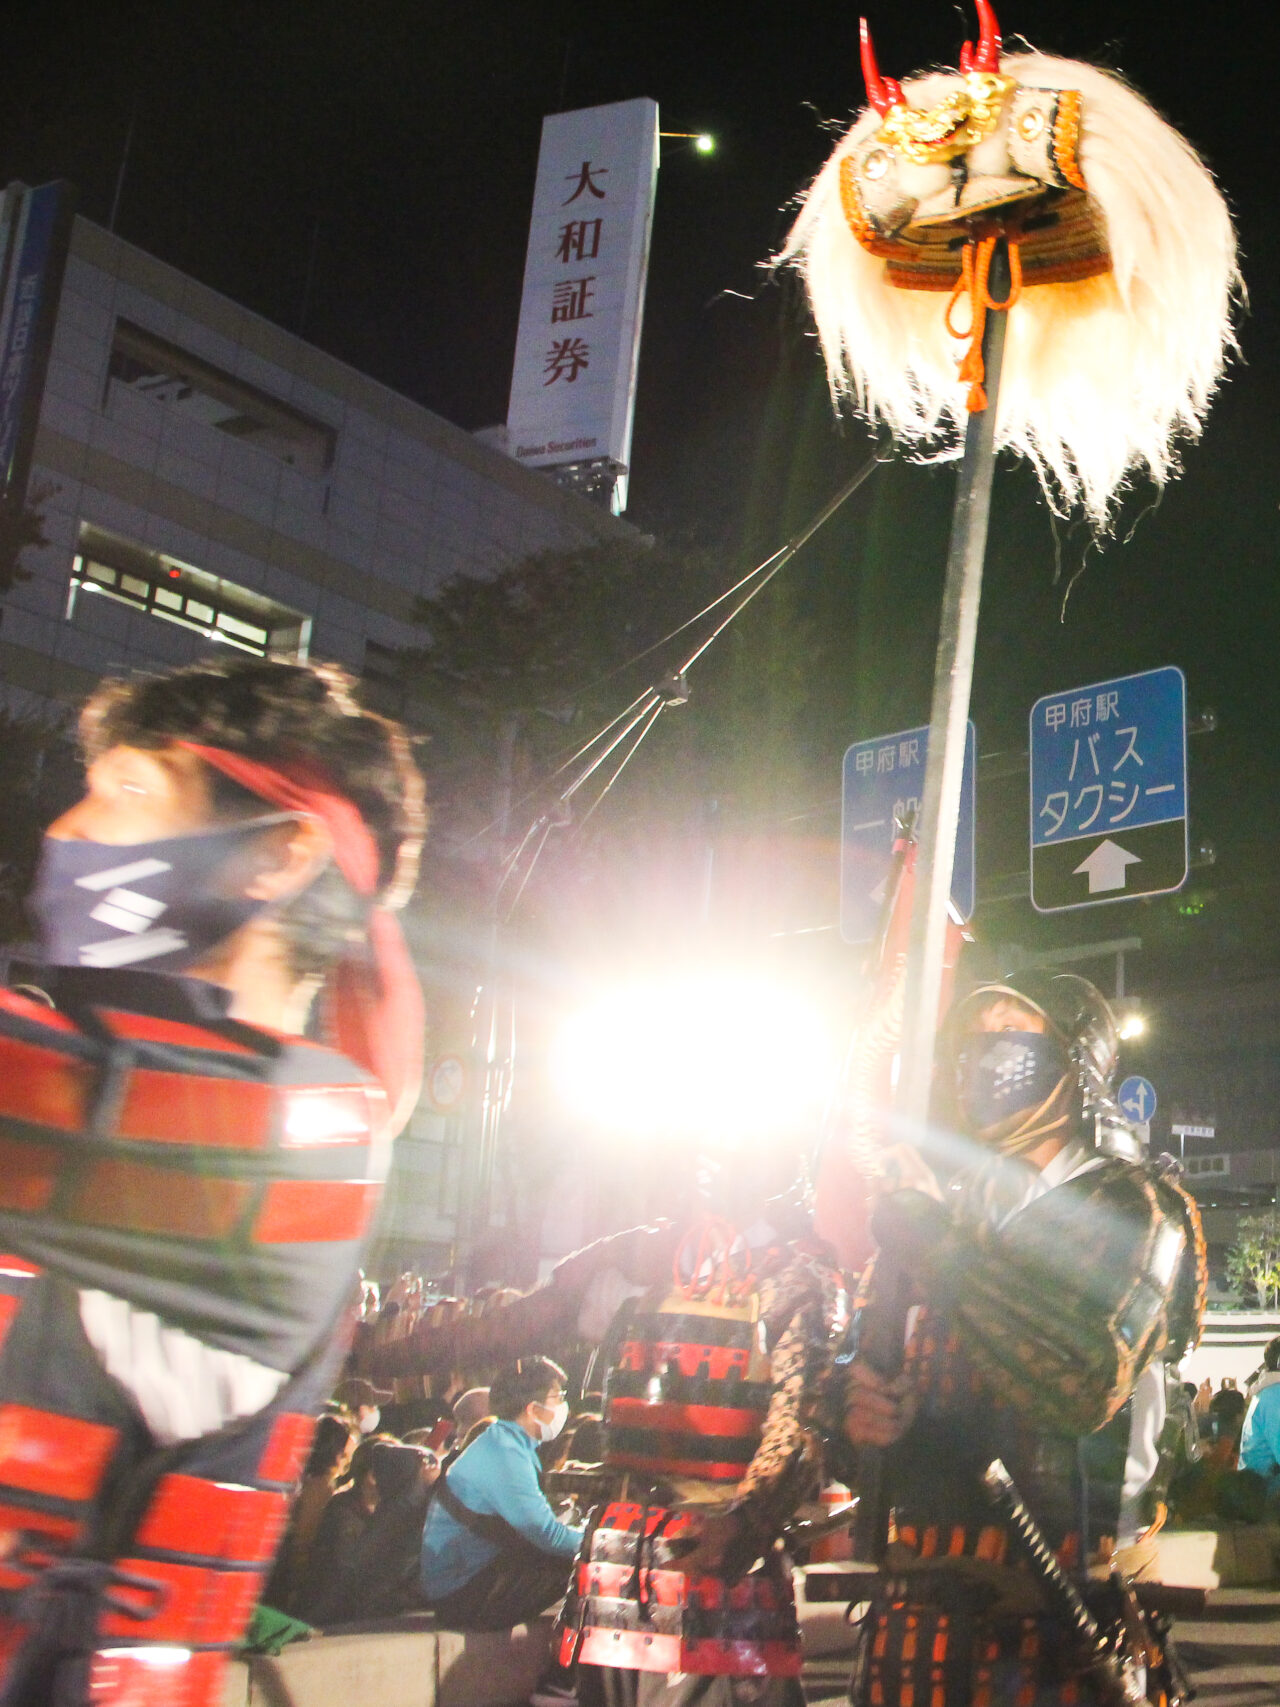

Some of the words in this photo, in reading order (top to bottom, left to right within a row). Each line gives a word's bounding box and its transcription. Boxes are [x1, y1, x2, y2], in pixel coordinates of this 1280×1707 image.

[543, 160, 609, 386] 大和証券
[547, 437, 597, 454] Securities
[1045, 690, 1120, 732] 甲府駅
[855, 739, 920, 776] 甲府駅
[1068, 726, 1144, 781] バス
[1039, 781, 1176, 837] タクシー
